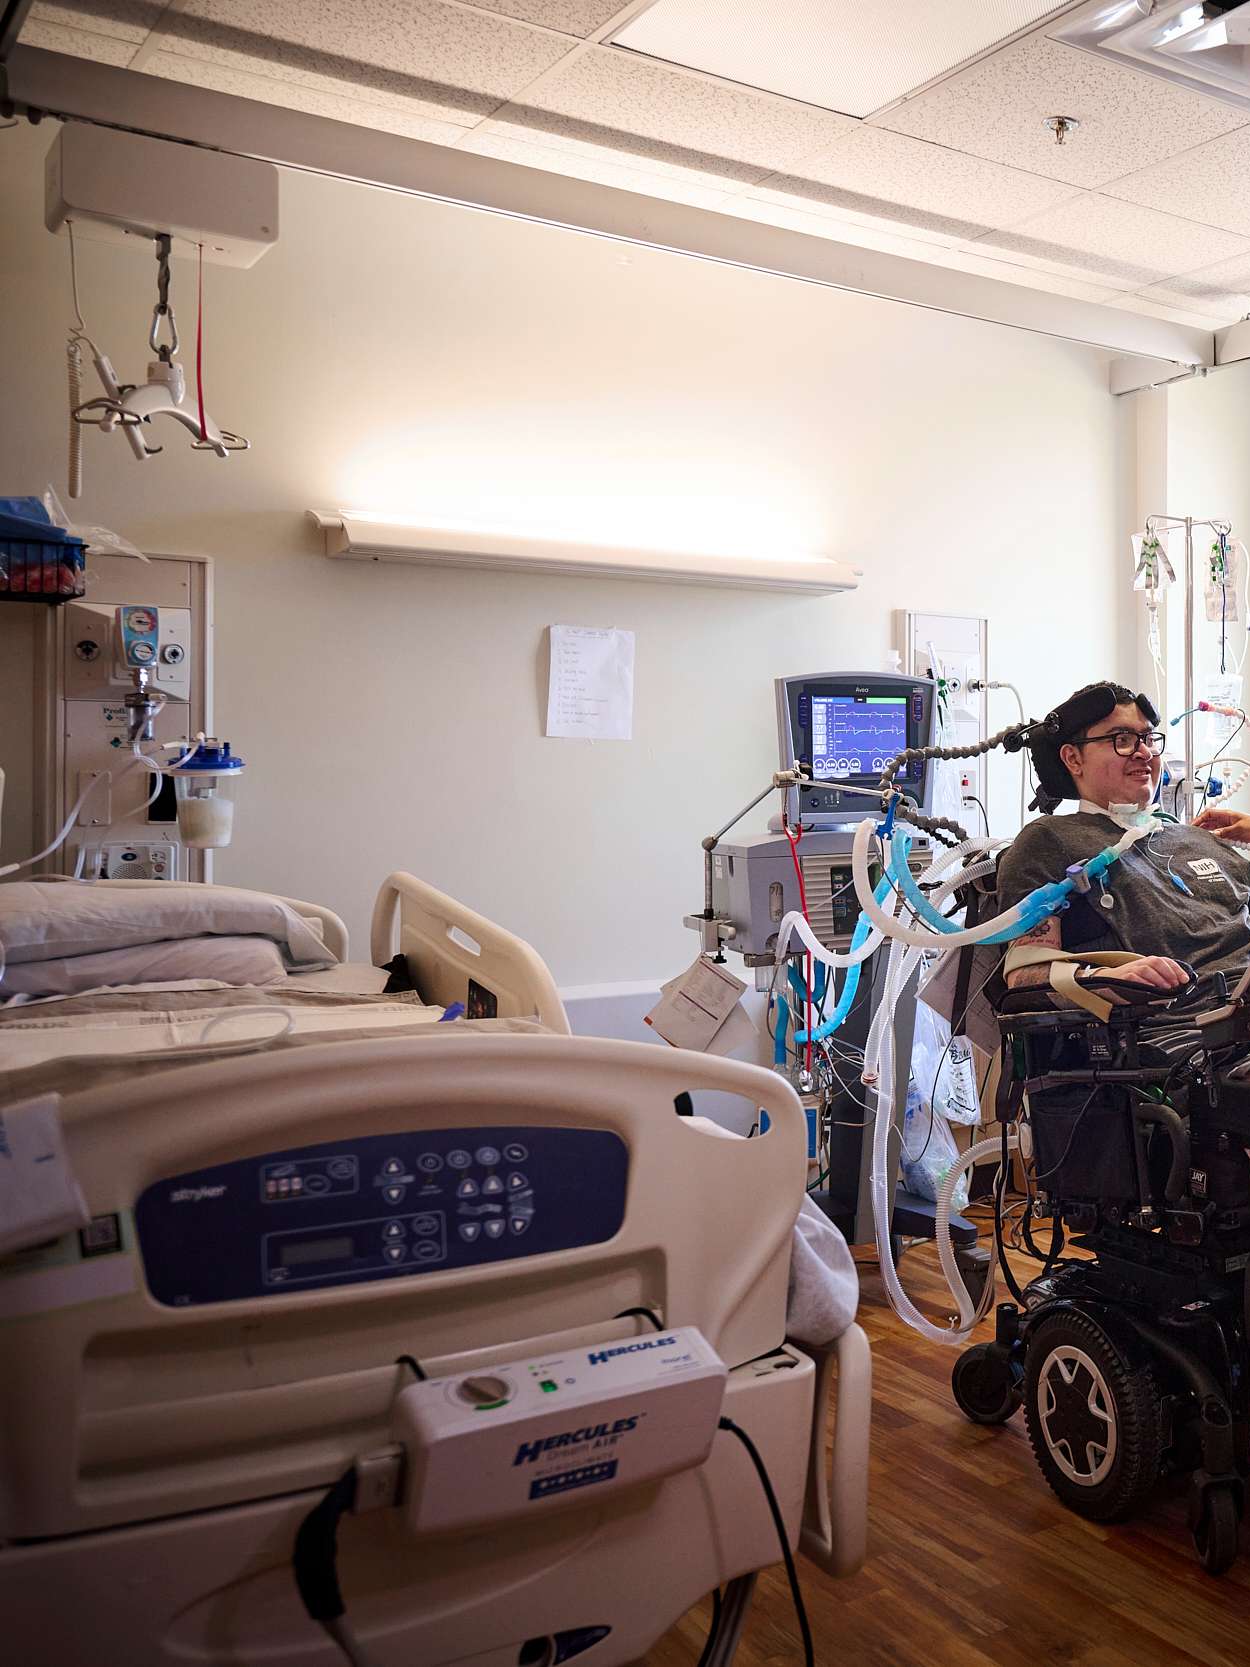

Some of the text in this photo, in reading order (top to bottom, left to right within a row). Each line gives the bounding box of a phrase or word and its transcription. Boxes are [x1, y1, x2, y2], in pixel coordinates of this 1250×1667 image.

[1191, 1171, 1205, 1182] JAY
[170, 1184, 228, 1203] stryker
[587, 1336, 677, 1366] HERCULES
[512, 1415, 639, 1466] HERCULES
